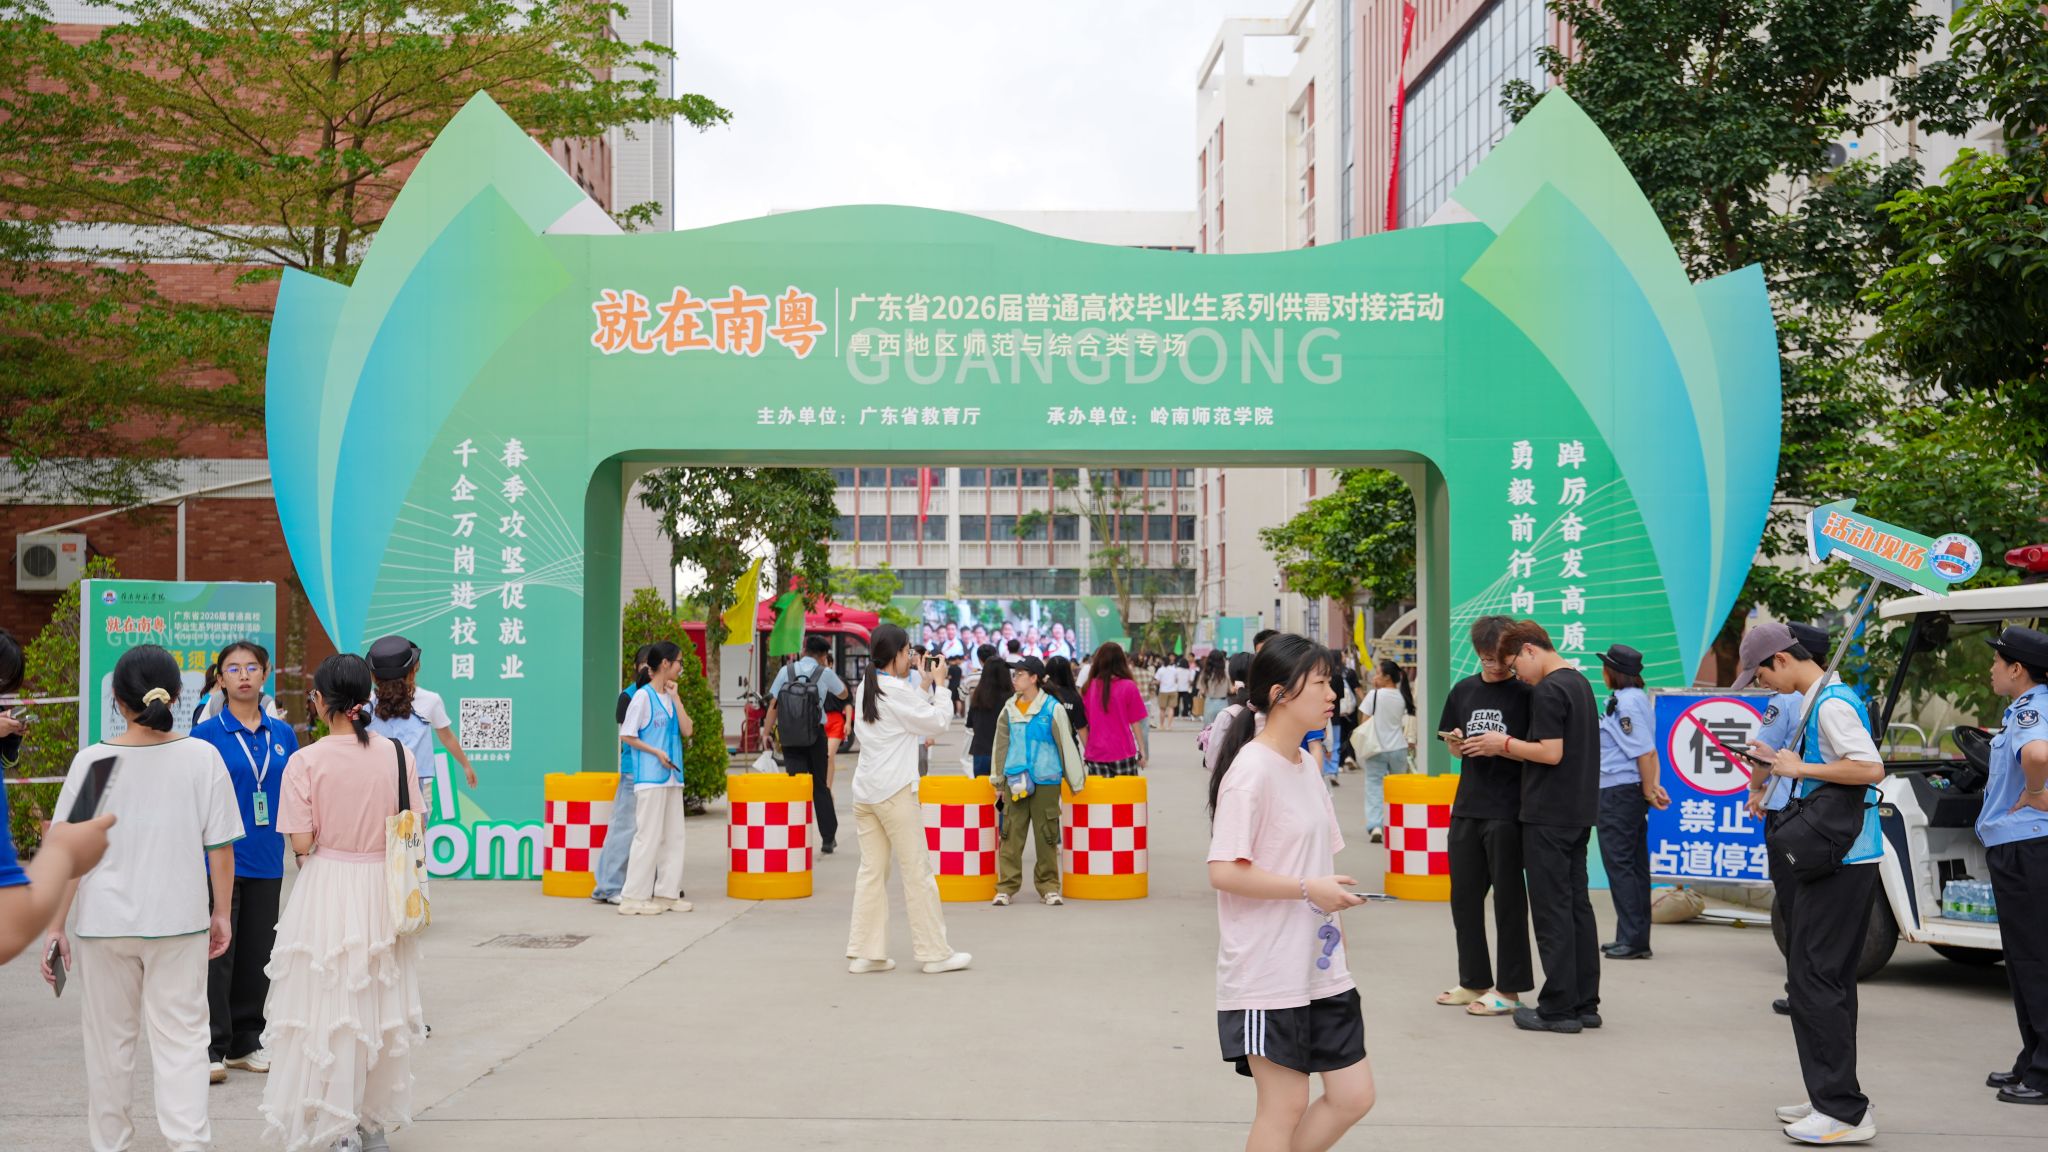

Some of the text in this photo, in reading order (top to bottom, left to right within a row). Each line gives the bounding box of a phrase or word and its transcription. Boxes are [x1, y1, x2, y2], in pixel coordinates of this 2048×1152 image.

[591, 286, 826, 359] 就在南粤
[849, 292, 1444, 323] 广东省2026届普通高校毕业生系列供需对接活动
[846, 326, 1343, 386] GUANGDONG
[849, 332, 1187, 358] 粤西地区师范与综合类专场
[450, 438, 478, 680] 千企万岗进校园
[499, 438, 528, 679] 春季攻坚促就业
[1822, 511, 1928, 571] 活动现场
[106, 615, 166, 634] 就在南粤
[174, 611, 260, 621] 广东省2026届普通高校
[1689, 717, 1752, 774] 停
[1679, 798, 1755, 834] 禁止
[1650, 839, 1770, 879] 占道停车
